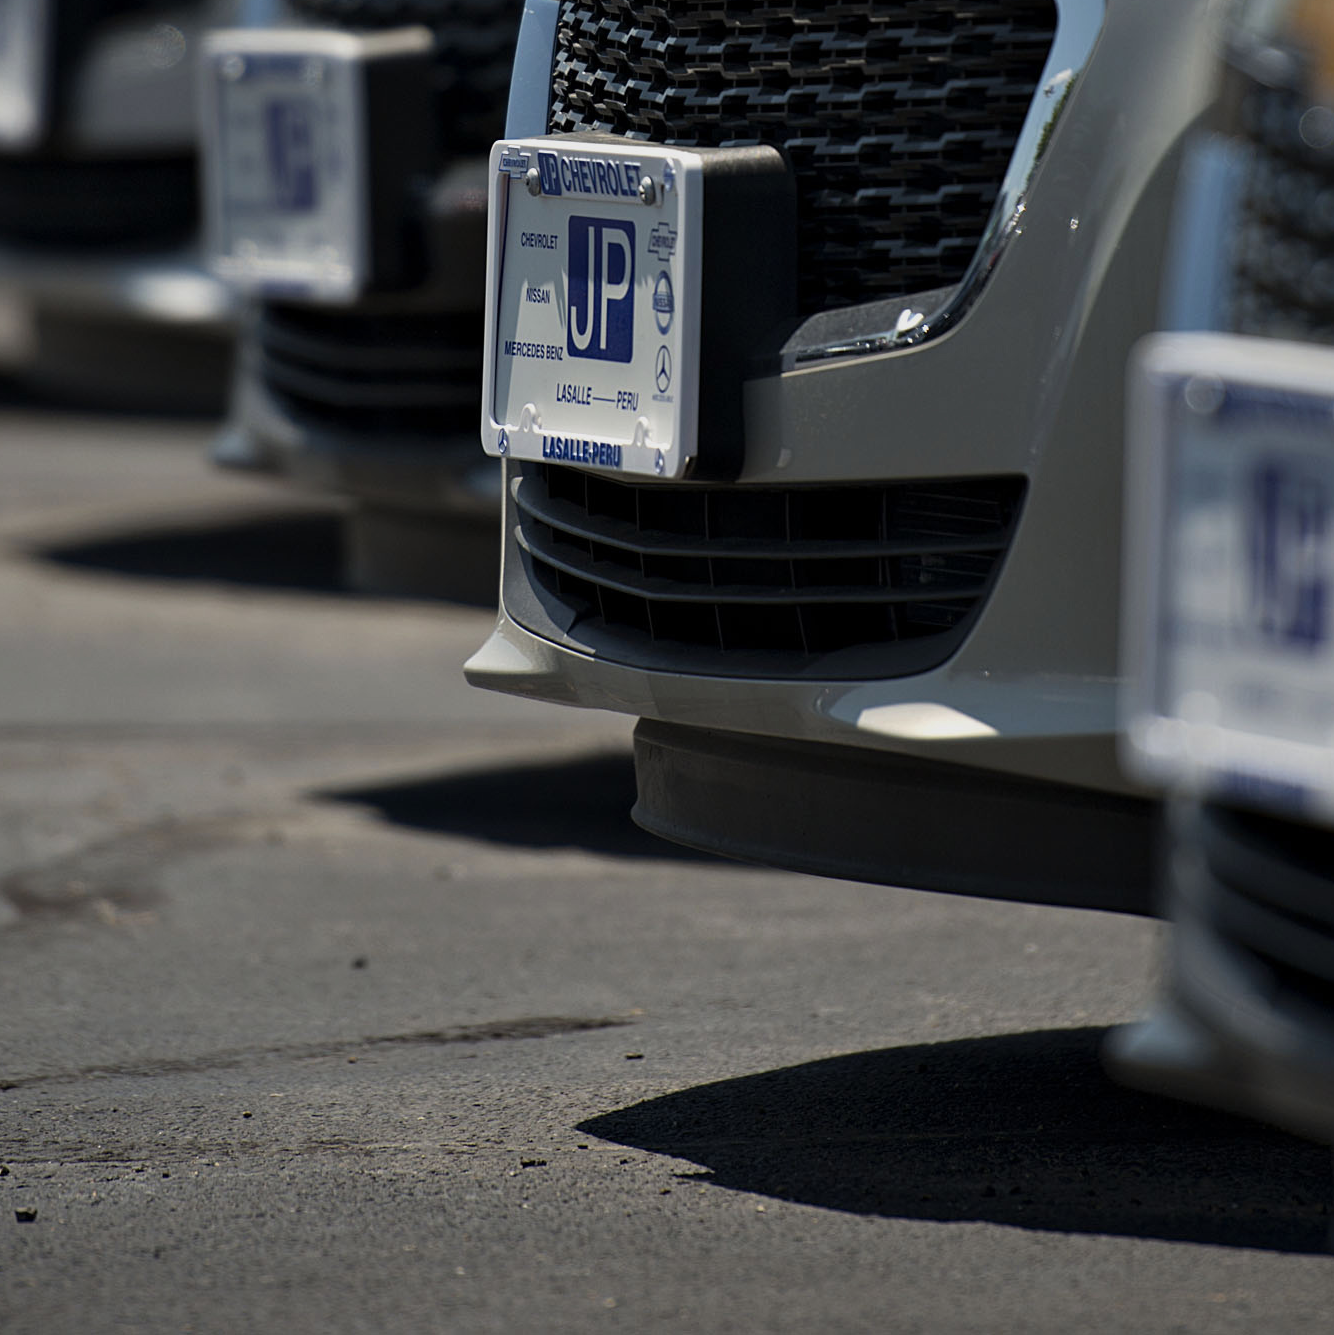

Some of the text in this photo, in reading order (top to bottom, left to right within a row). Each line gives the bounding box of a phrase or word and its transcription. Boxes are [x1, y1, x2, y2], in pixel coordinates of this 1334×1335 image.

[542, 153, 641, 197] JP CHEVROLET
[520, 232, 558, 249] CHEVROLET
[526, 287, 551, 304] NISSAN
[570, 226, 632, 351] JP
[504, 340, 564, 361] MERCEDES BENZ
[556, 383, 592, 405] LASALLE
[616, 390, 639, 411] PERU
